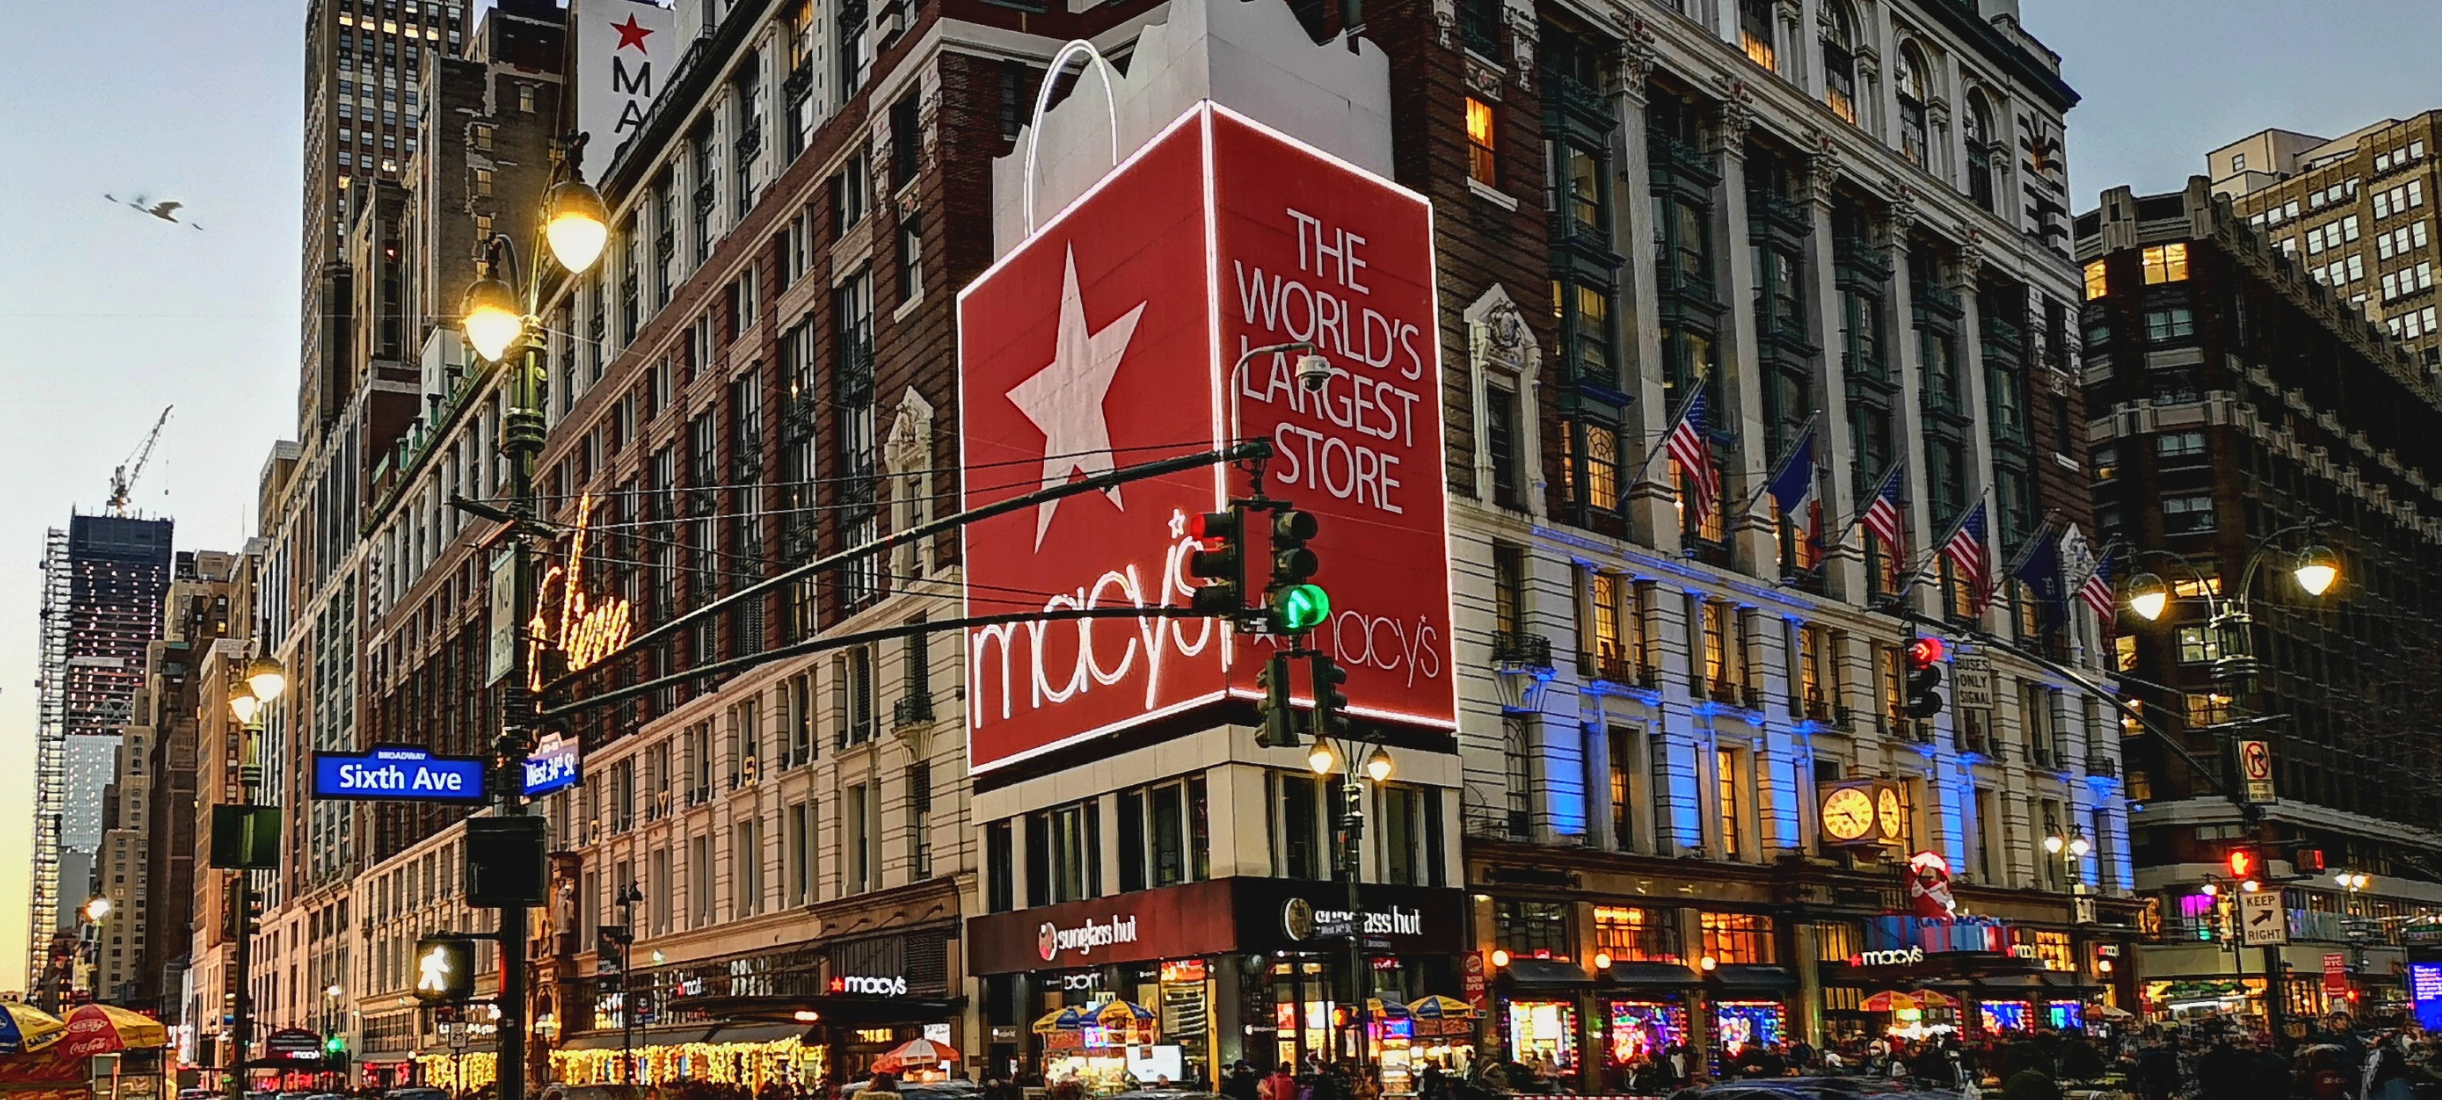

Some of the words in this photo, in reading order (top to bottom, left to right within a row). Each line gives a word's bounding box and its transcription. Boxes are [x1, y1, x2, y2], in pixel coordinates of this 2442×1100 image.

[1286, 208, 1370, 295] THE
[1233, 258, 1422, 381] WORLD'S
[1240, 334, 1420, 447] LARGEST
[1274, 422, 1403, 515] STORE
[1955, 657, 1991, 671] BUSES
[1960, 674, 1988, 688] ONLY
[1960, 690, 1992, 705] SIGNAL
[340, 764, 405, 790] Sixth
[412, 766, 462, 791] Ave
[526, 761, 547, 787] West
[563, 752, 575, 776] St
[2246, 895, 2276, 907] KEEP
[1393, 904, 1423, 935] hut
[1058, 918, 1112, 955] sunglass
[1112, 914, 1138, 943] hut
[2248, 929, 2281, 941] RIGHT
[1862, 945, 1924, 967] macy's
[844, 975, 907, 997] macy's
[1466, 983, 1485, 991] OPEN
